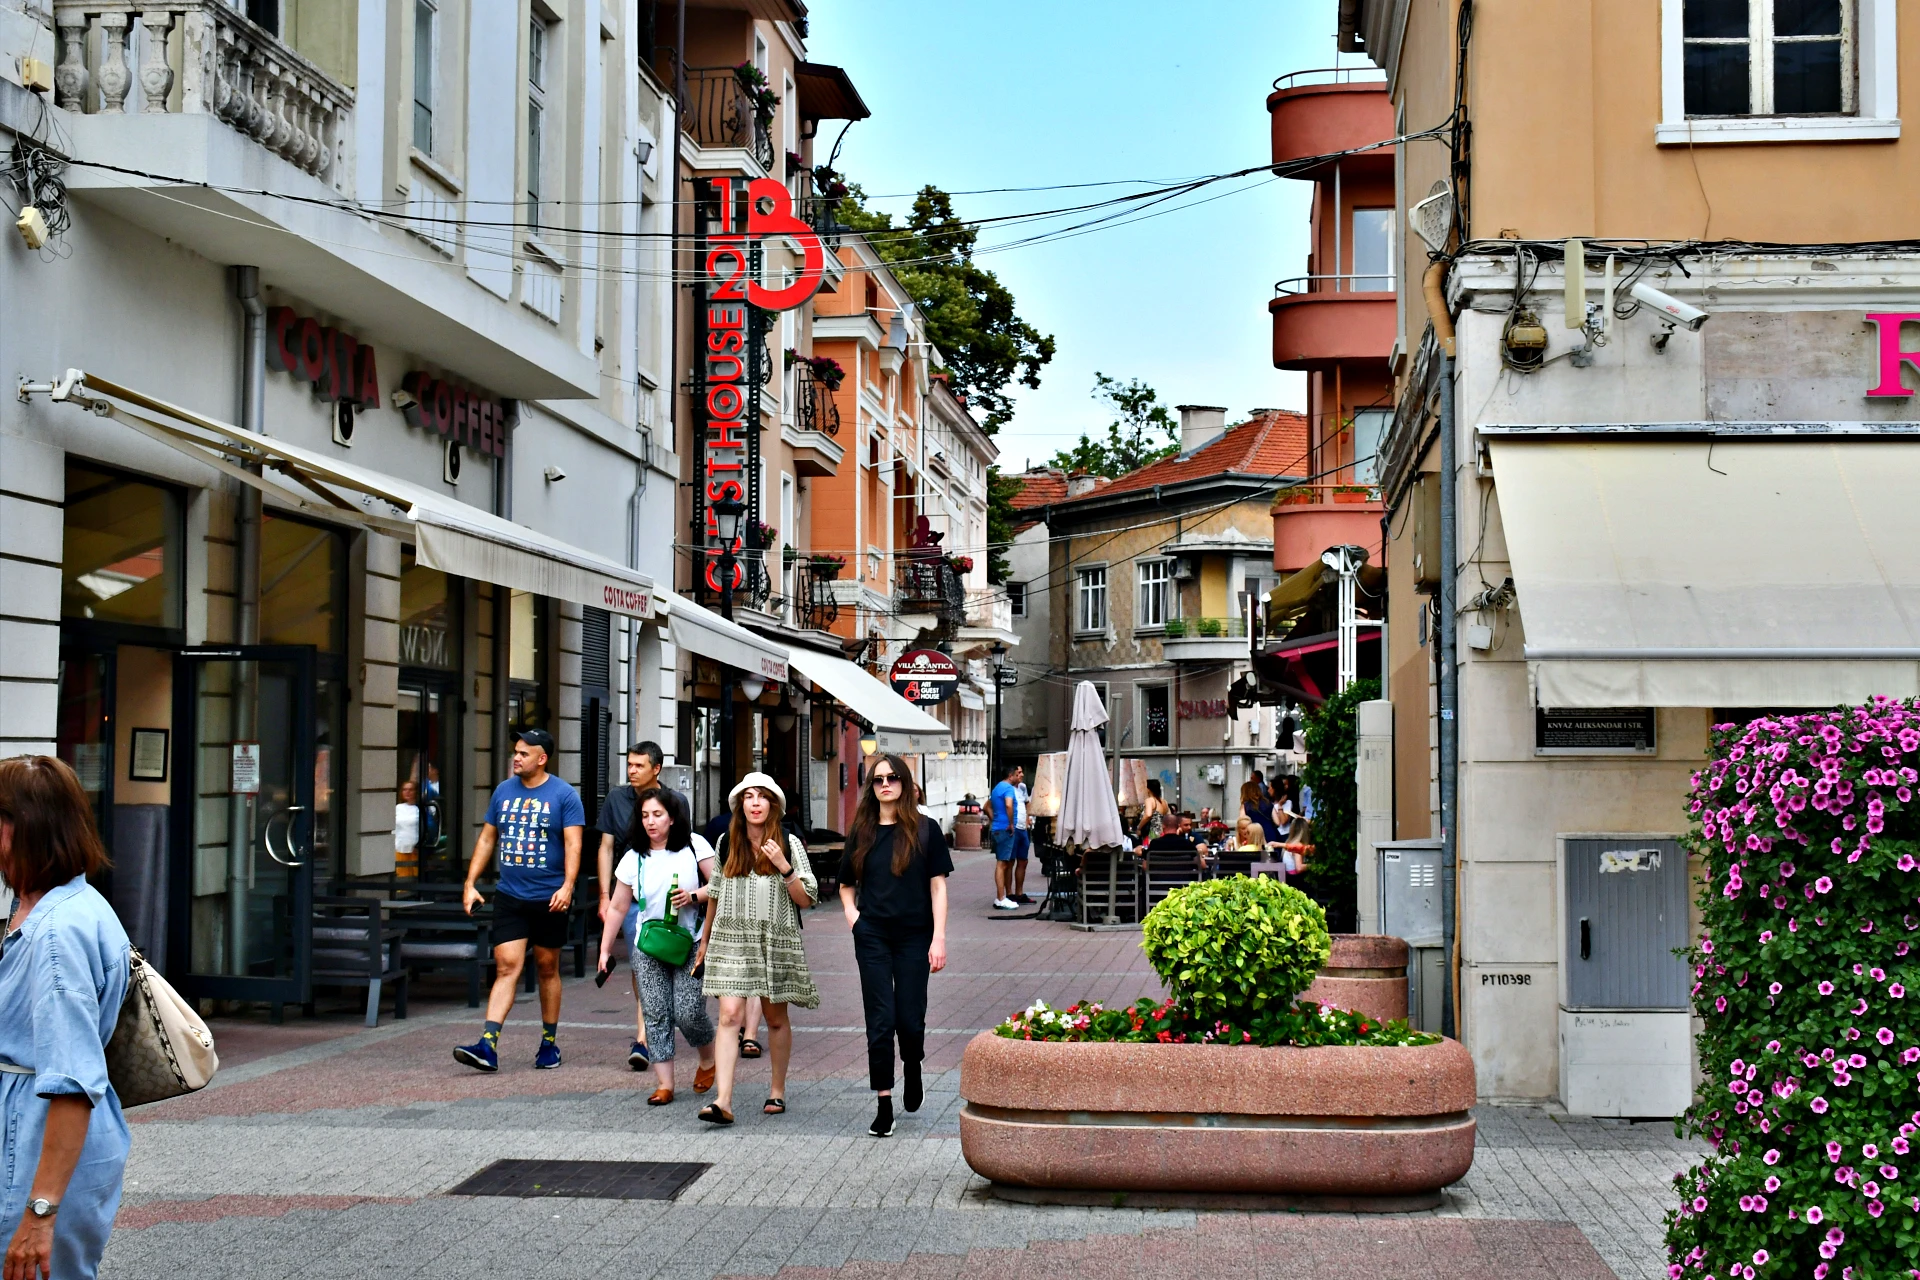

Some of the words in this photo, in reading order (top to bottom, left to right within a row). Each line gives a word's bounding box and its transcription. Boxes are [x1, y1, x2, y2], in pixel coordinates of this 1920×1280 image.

[276, 306, 380, 410] COSTA
[415, 370, 505, 458] COFFEE
[707, 308, 745, 449] HOUSE
[603, 585, 625, 609] COSTA
[625, 591, 648, 614] COFFEE
[760, 657, 773, 675] COSTA
[926, 662, 954, 670] ANTICA
